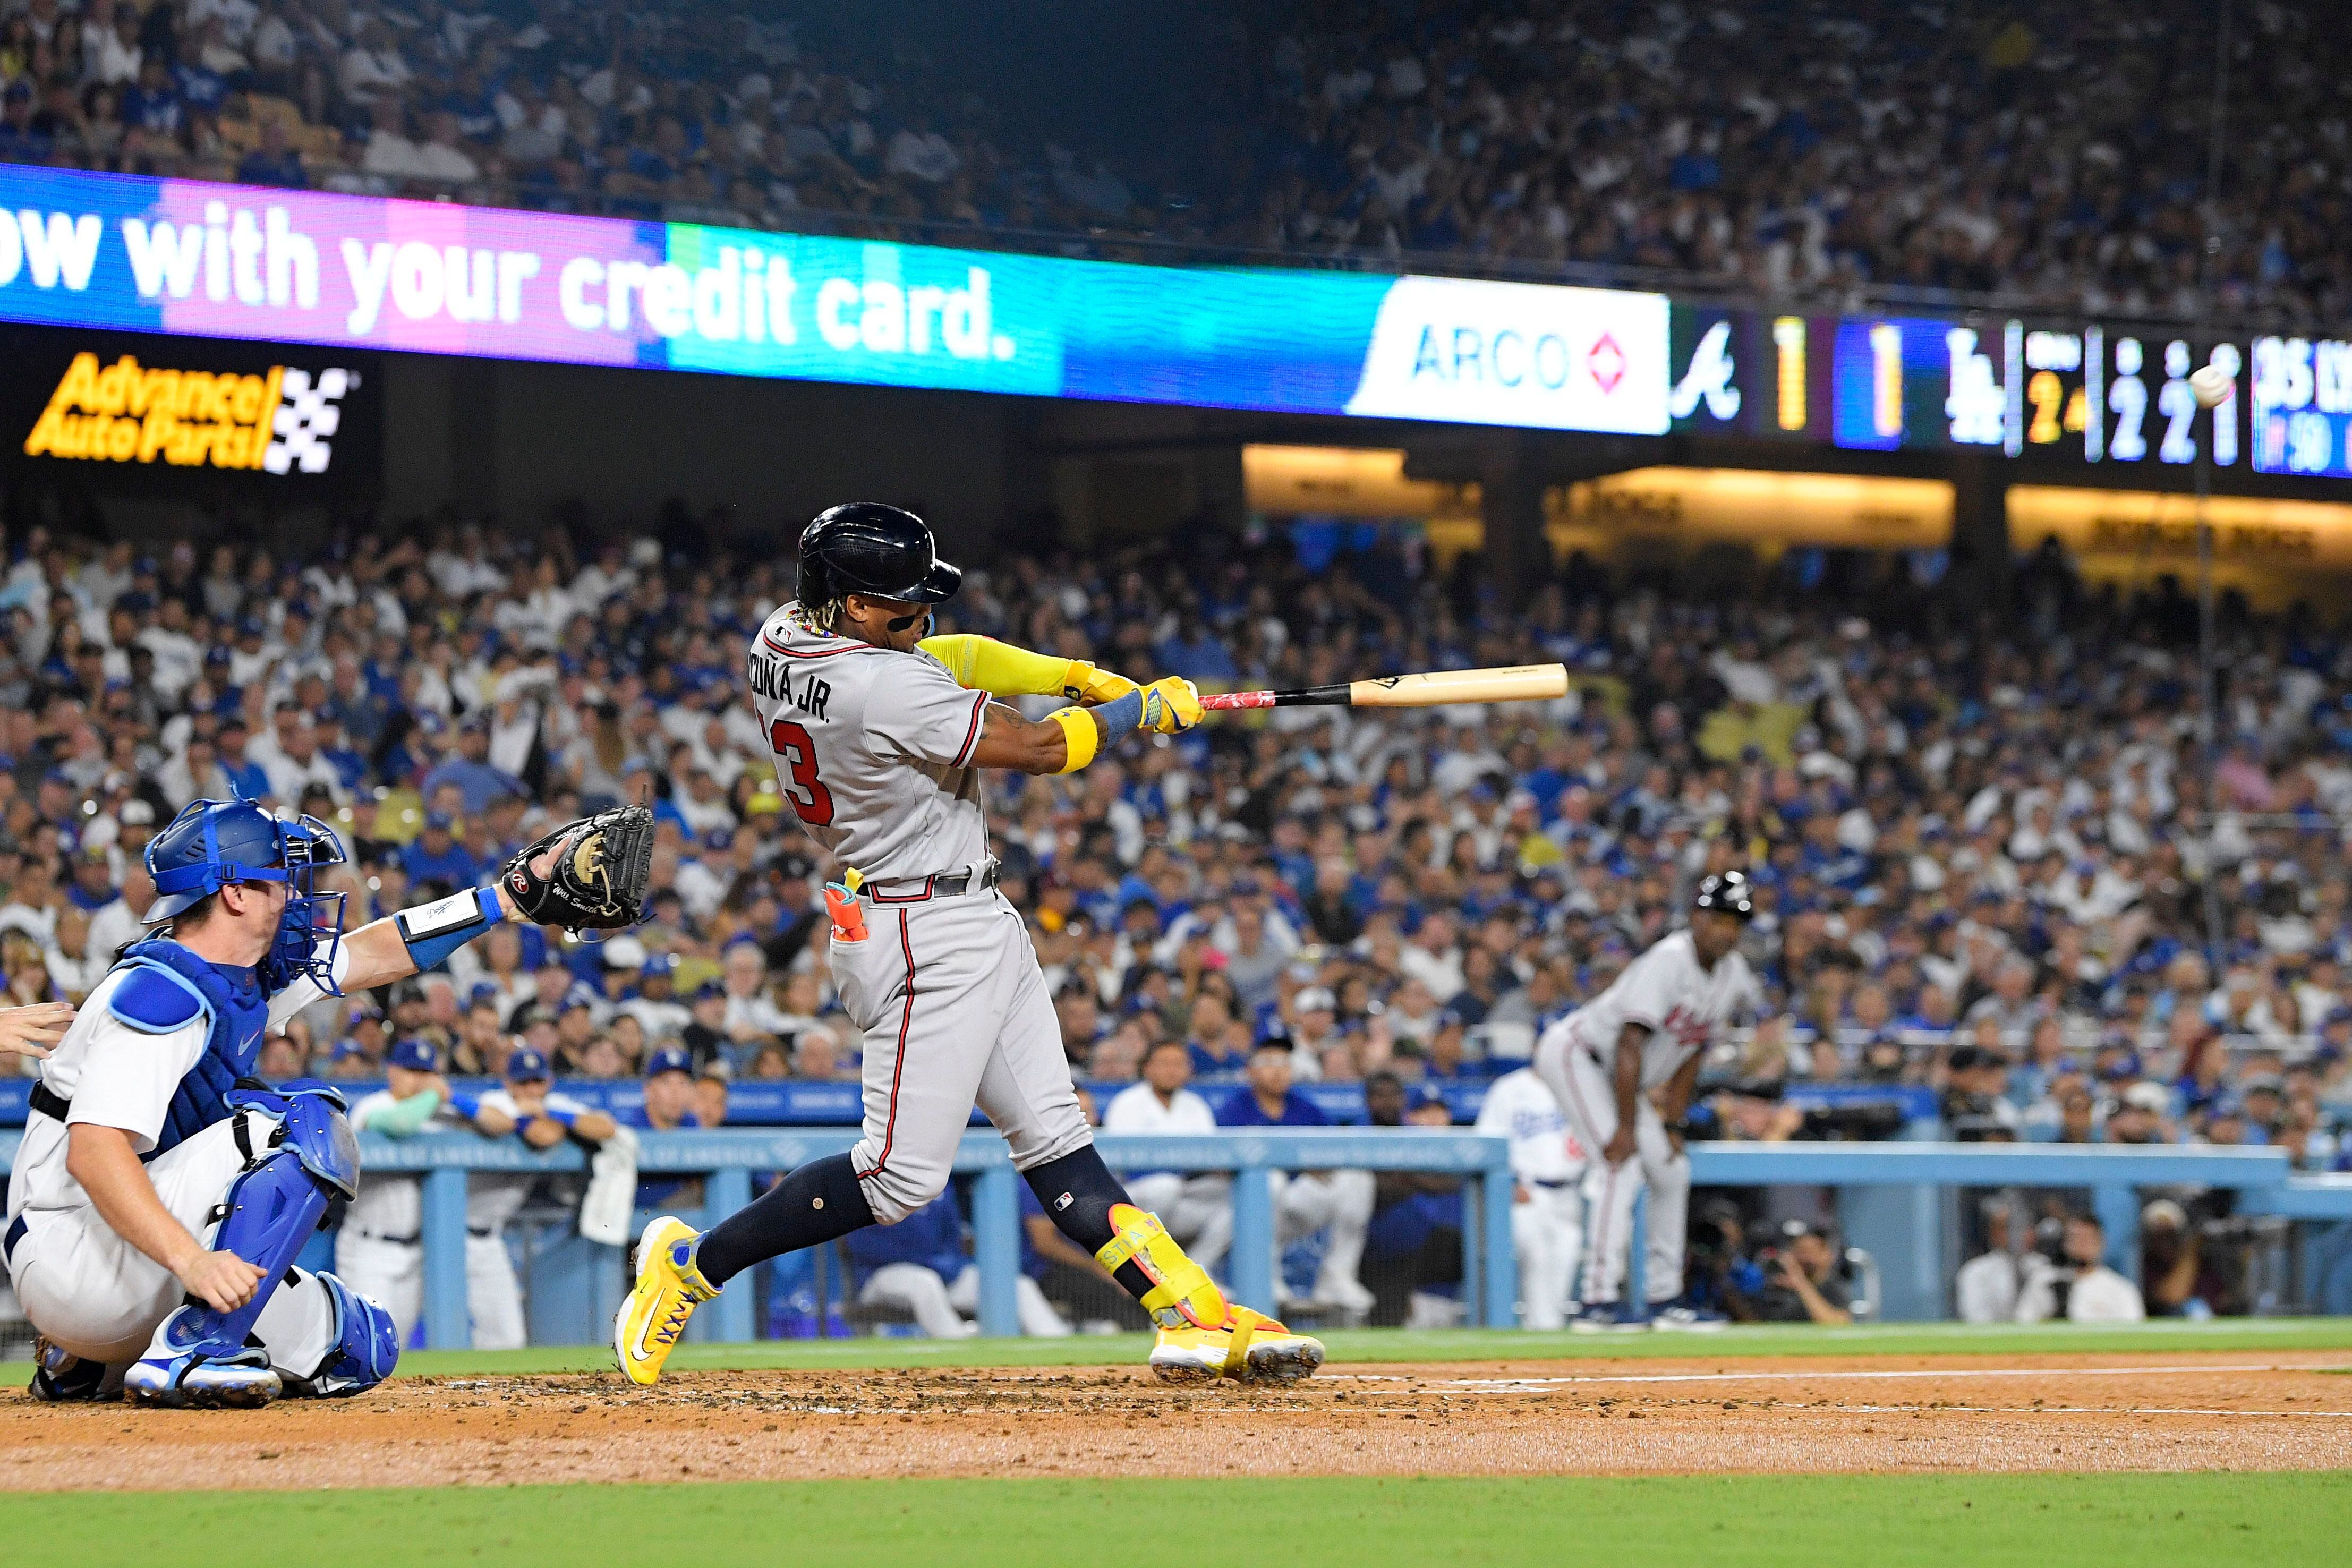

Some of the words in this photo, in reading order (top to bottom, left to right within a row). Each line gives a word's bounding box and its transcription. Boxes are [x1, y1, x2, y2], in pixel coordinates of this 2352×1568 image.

[122, 201, 317, 309] with
[342, 239, 541, 336] your
[559, 246, 797, 345] credit
[816, 267, 1015, 361] card.
[52, 352, 269, 423] Advance
[1412, 324, 1569, 389] ARCO
[1773, 316, 1805, 431] 1
[1870, 325, 1902, 437] 1
[24, 409, 138, 463] Auto
[136, 412, 261, 469] Parts
[2027, 370, 2062, 444] 2
[2109, 374, 2149, 462] 2
[2158, 378, 2197, 464] 2
[749, 652, 794, 705] CUÑA
[797, 675, 830, 724] JR.
[552, 882, 571, 901] Will
[570, 898, 599, 914] Smith
